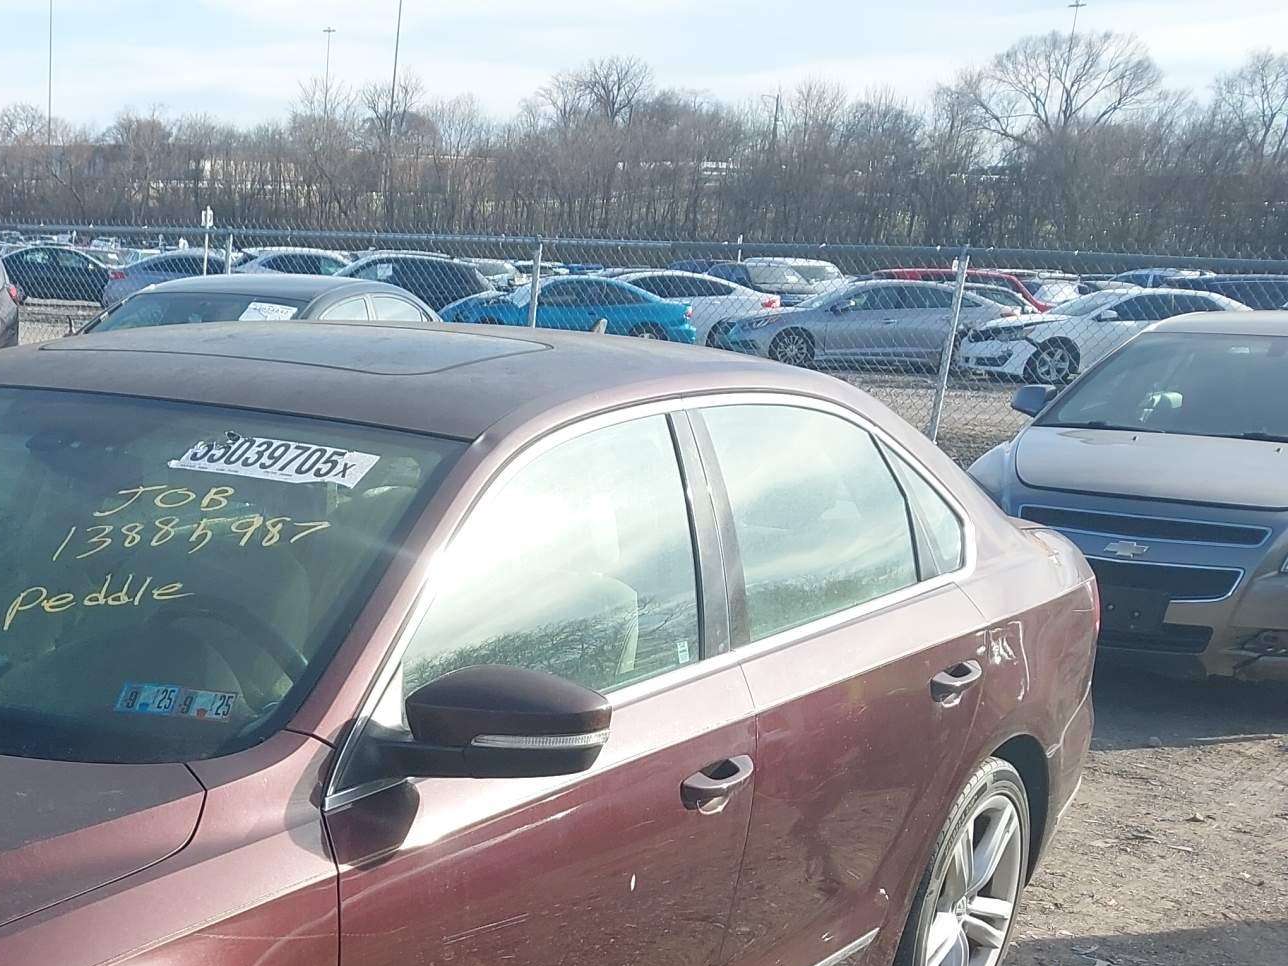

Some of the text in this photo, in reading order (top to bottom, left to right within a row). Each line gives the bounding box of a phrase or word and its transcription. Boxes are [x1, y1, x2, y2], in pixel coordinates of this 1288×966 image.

[92, 485, 235, 517] JOB
[52, 513, 331, 561] 13885987
[156, 688, 177, 710] 25
[214, 694, 234, 717] 25
